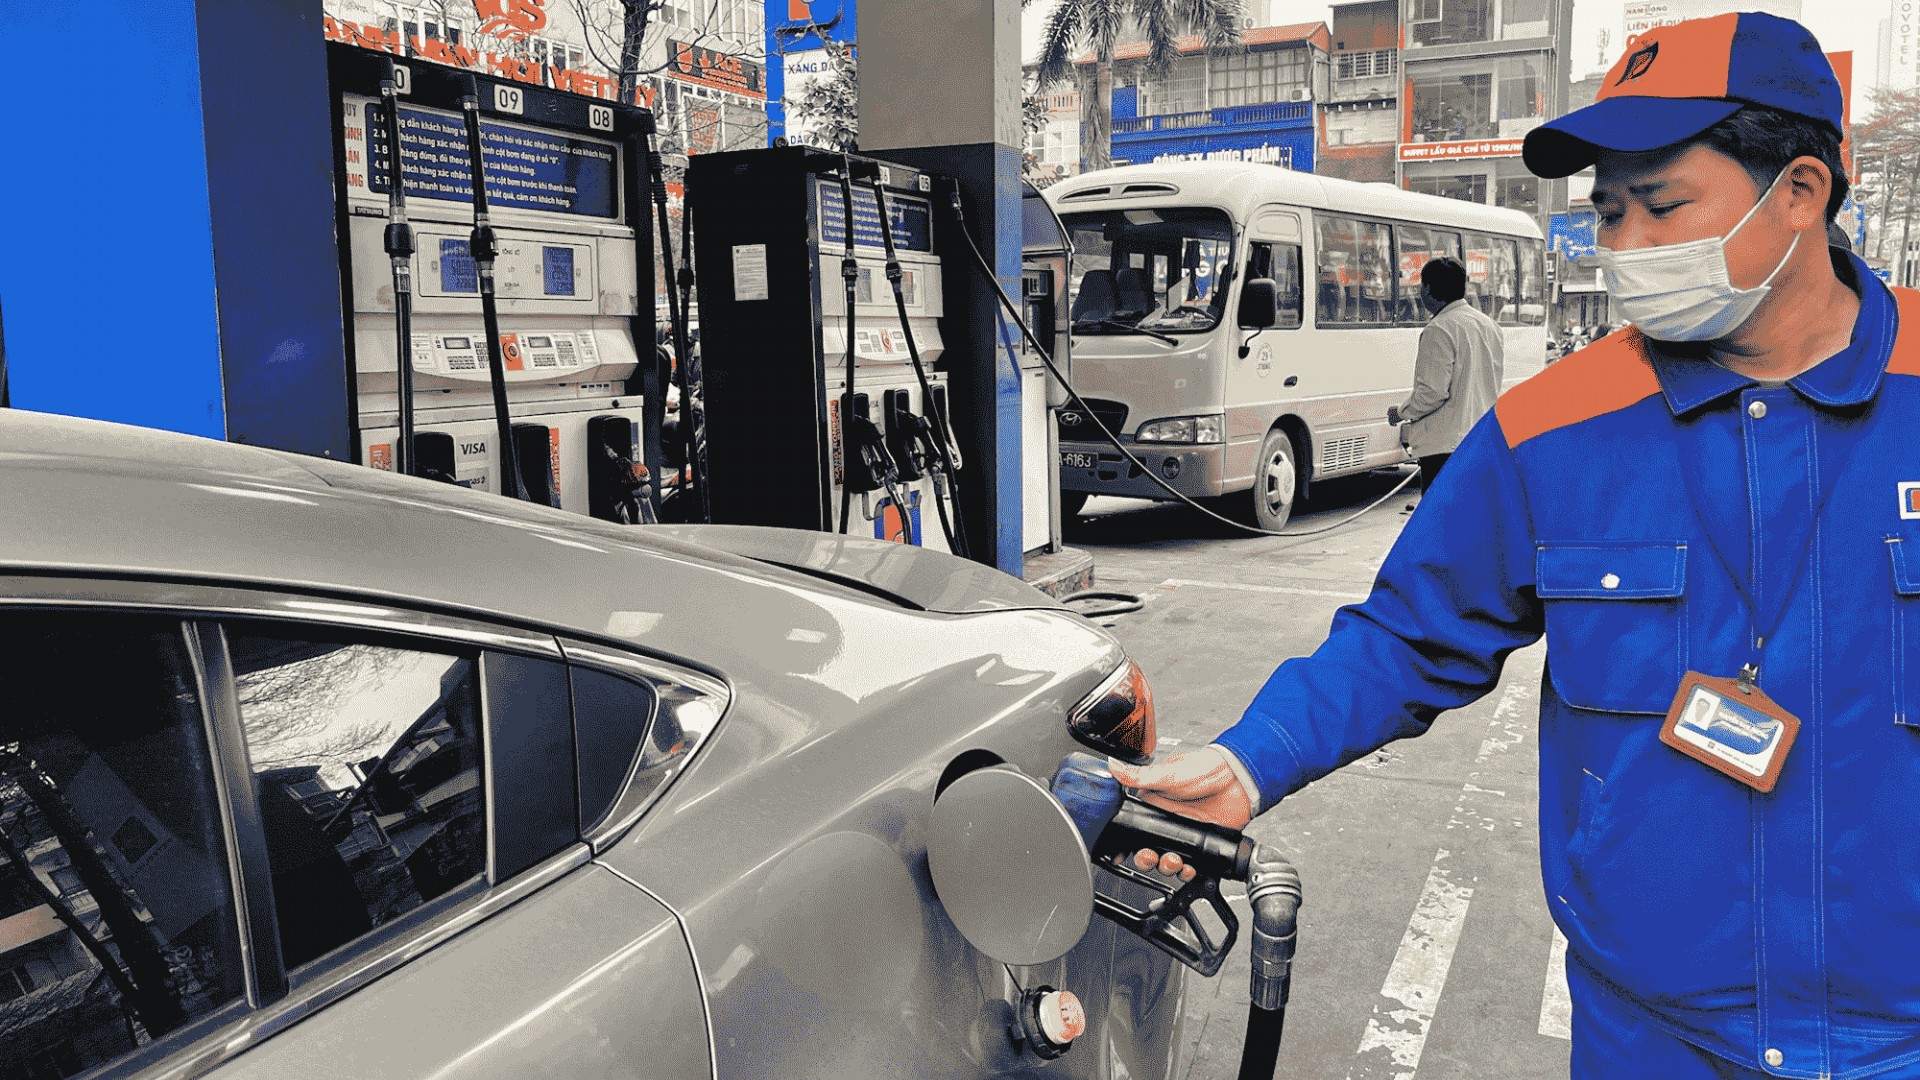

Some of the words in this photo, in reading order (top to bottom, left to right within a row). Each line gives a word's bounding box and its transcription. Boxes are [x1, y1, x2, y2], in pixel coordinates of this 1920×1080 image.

[499, 88, 519, 110] 09
[593, 108, 610, 128] 08
[460, 443, 486, 455] VISA
